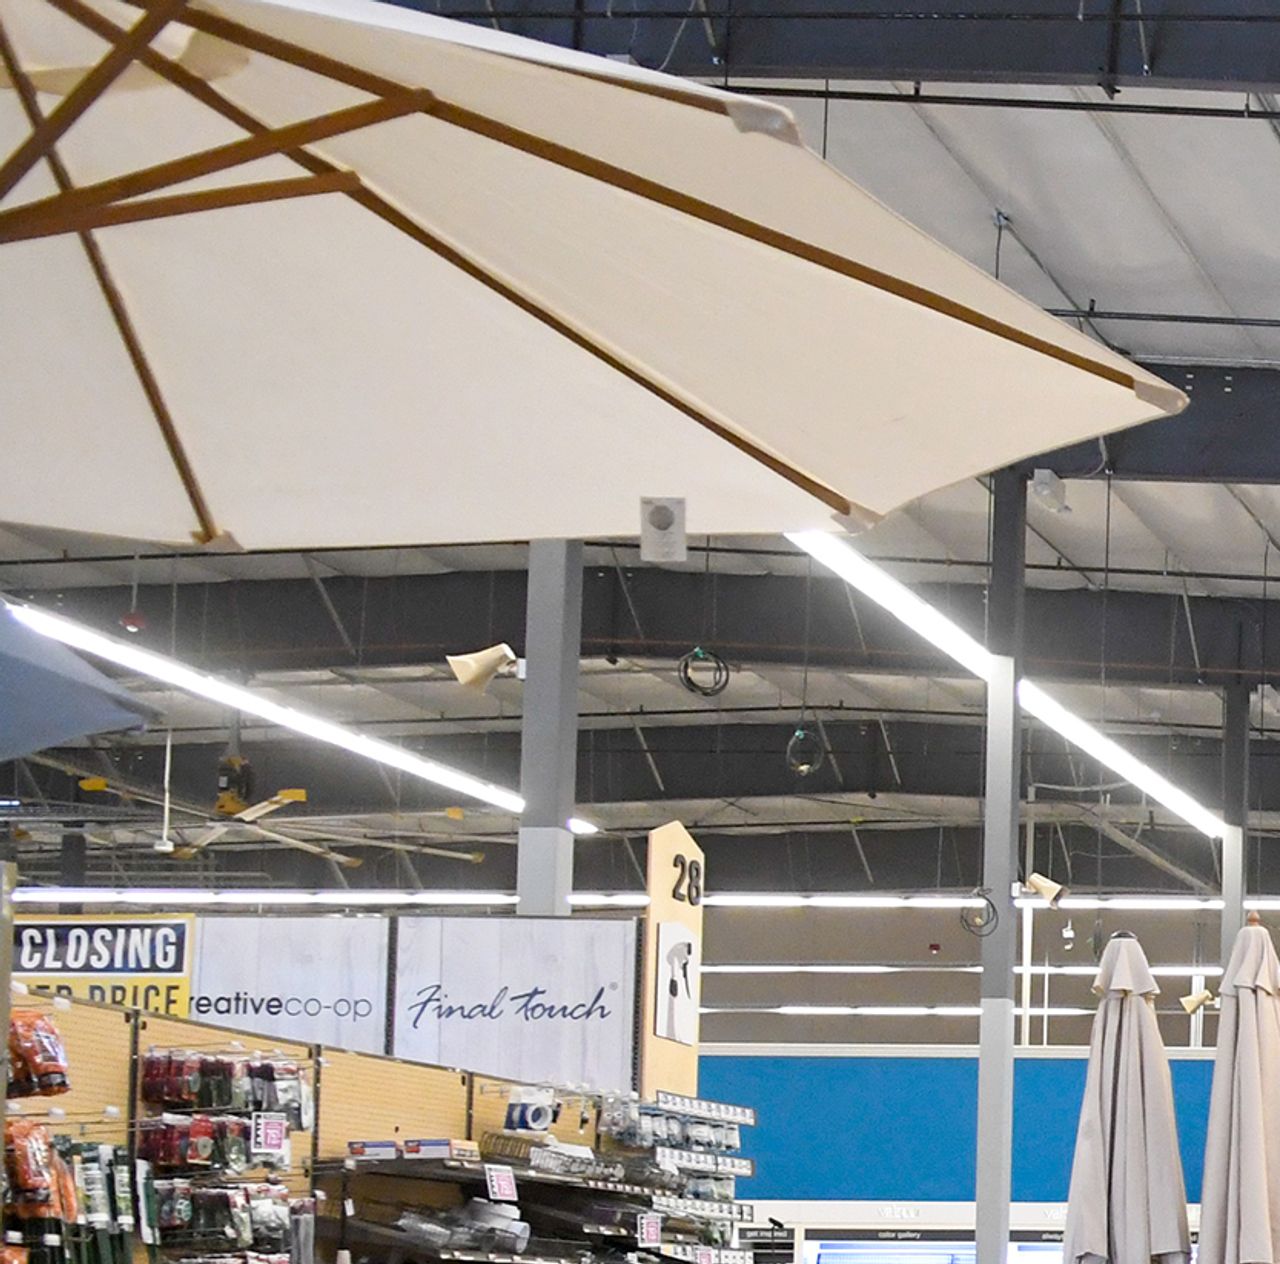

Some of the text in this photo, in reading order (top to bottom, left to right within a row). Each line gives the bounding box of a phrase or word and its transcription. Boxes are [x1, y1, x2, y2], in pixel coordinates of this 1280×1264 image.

[672, 854, 702, 906] 28
[20, 927, 177, 970] CLOSING
[189, 992, 373, 1022] reativeco-op
[408, 984, 509, 1029] Final
[897, 1230, 921, 1241] gallery
